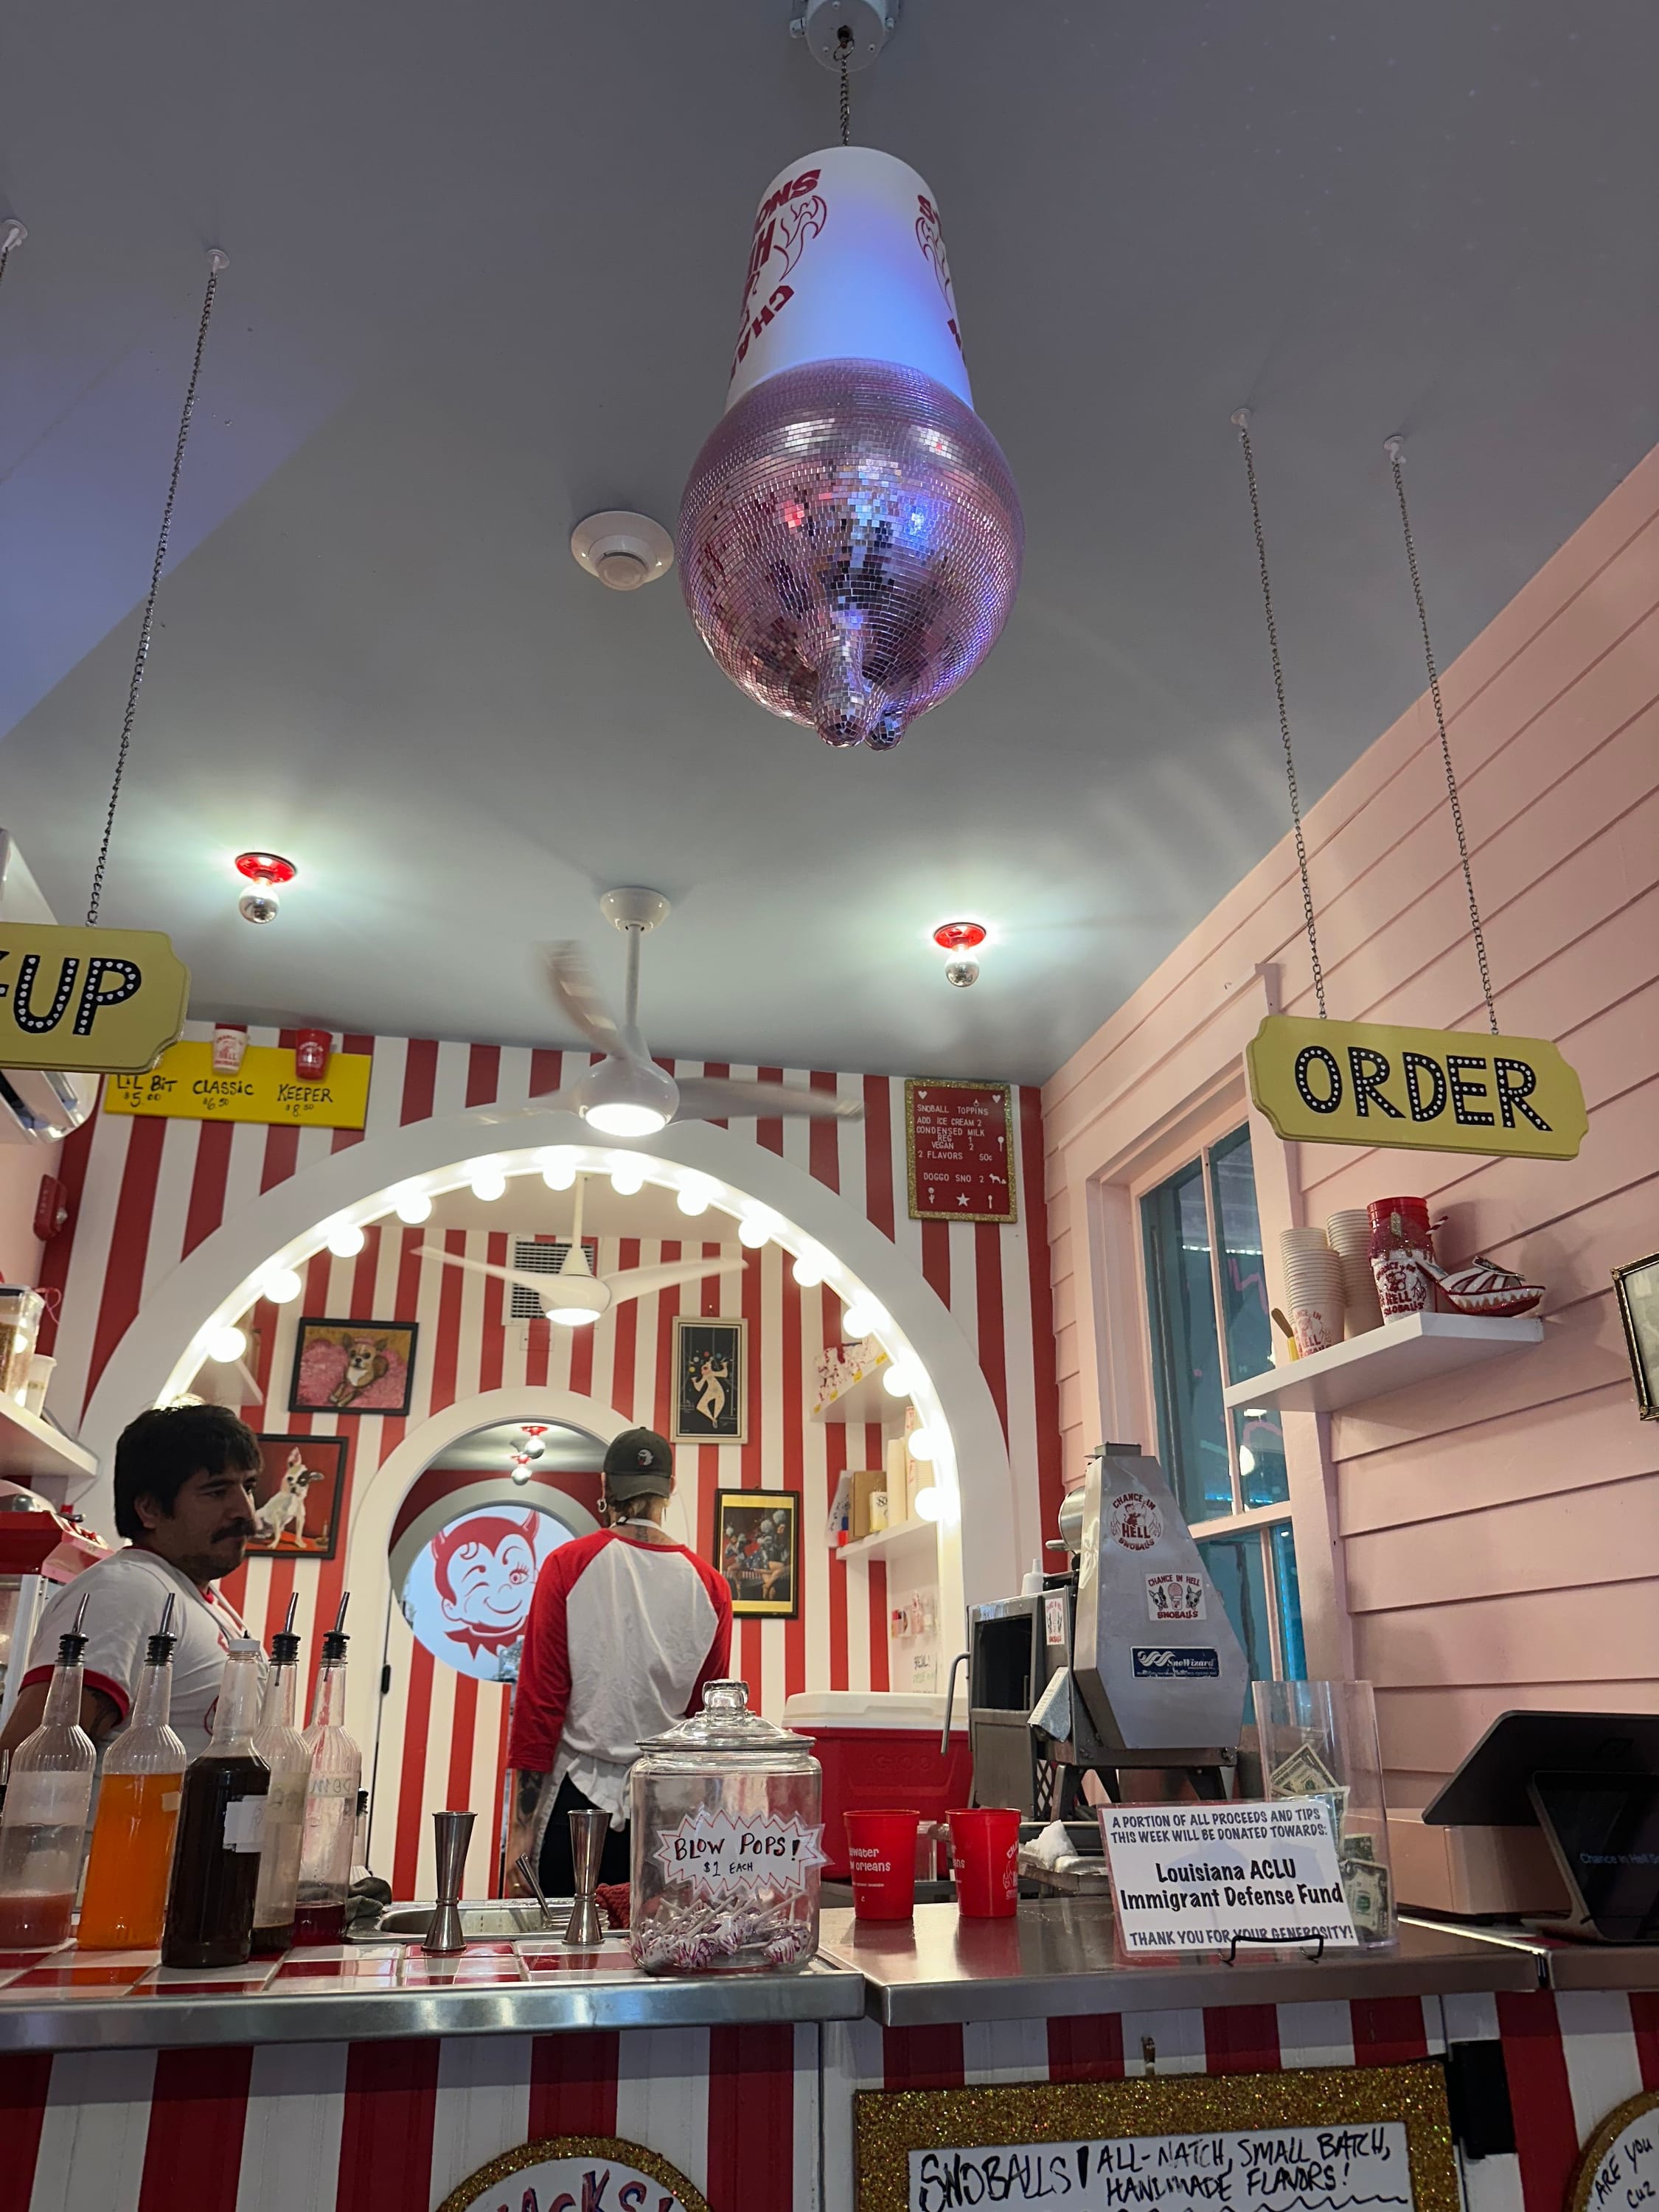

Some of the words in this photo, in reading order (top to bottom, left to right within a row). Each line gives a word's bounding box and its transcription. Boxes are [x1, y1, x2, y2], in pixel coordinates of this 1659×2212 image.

[276, 1084, 333, 1103] KEEPER
[1295, 1046, 1553, 1132] ORDER
[917, 1105, 949, 1113] SNOBALL
[917, 1117, 931, 1125] ADD
[951, 1119, 975, 1127] CREAM
[917, 1126, 963, 1136] CONDENSED
[931, 1141, 954, 1150] VEGAN
[927, 1151, 963, 1160] FLAVORS
[923, 1172, 950, 1181] DOGGO
[955, 1175, 972, 1183] SNO
[1385, 1292, 1412, 1305] HELL
[1113, 1492, 1144, 1509] CHANCE
[1146, 1499, 1156, 1510] IN
[1121, 1523, 1151, 1539] HELL
[1119, 1537, 1155, 1551] SNOBALLS
[1148, 1574, 1173, 1587] CHANCE
[1176, 1574, 1183, 1582] IN
[1186, 1576, 1200, 1587] HELL
[1157, 1610, 1199, 1619] SNOBALLS
[1166, 1658, 1214, 1667] SnoWizard
[1112, 1816, 1121, 1829] A
[1123, 1814, 1171, 1828] PORTION
[1173, 1814, 1187, 1826] OF
[1190, 1812, 1211, 1826] ALL
[1213, 1811, 1268, 1825] PROCEEDS
[1270, 1809, 1293, 1823] AND
[1295, 1808, 1321, 1821] TIPS
[1110, 1831, 1137, 1844] THIS
[1138, 1829, 1170, 1843] WEEK
[1172, 1829, 1200, 1842] WILL
[1201, 1828, 1216, 1841] BE
[1218, 1826, 1267, 1840] DONATED
[1270, 1823, 1327, 1838] TOWARDS:
[674, 1837, 726, 1860] BLOW
[703, 1861, 721, 1877] $1
[729, 1862, 754, 1874] EACH
[1155, 1862, 1245, 1884] Louisiana
[1250, 1858, 1296, 1879] ACLU
[1120, 1888, 1219, 1912] Immigrant
[1224, 1885, 1295, 1907] Defense
[1296, 1882, 1344, 1905] Fund
[1130, 1931, 1176, 1947] THANK
[1178, 1930, 1203, 1945] YOU
[1208, 1929, 1231, 1944] FOR
[1237, 2137, 1311, 2168] SMALL
[1248, 2162, 1351, 2196] FLAVORS!
